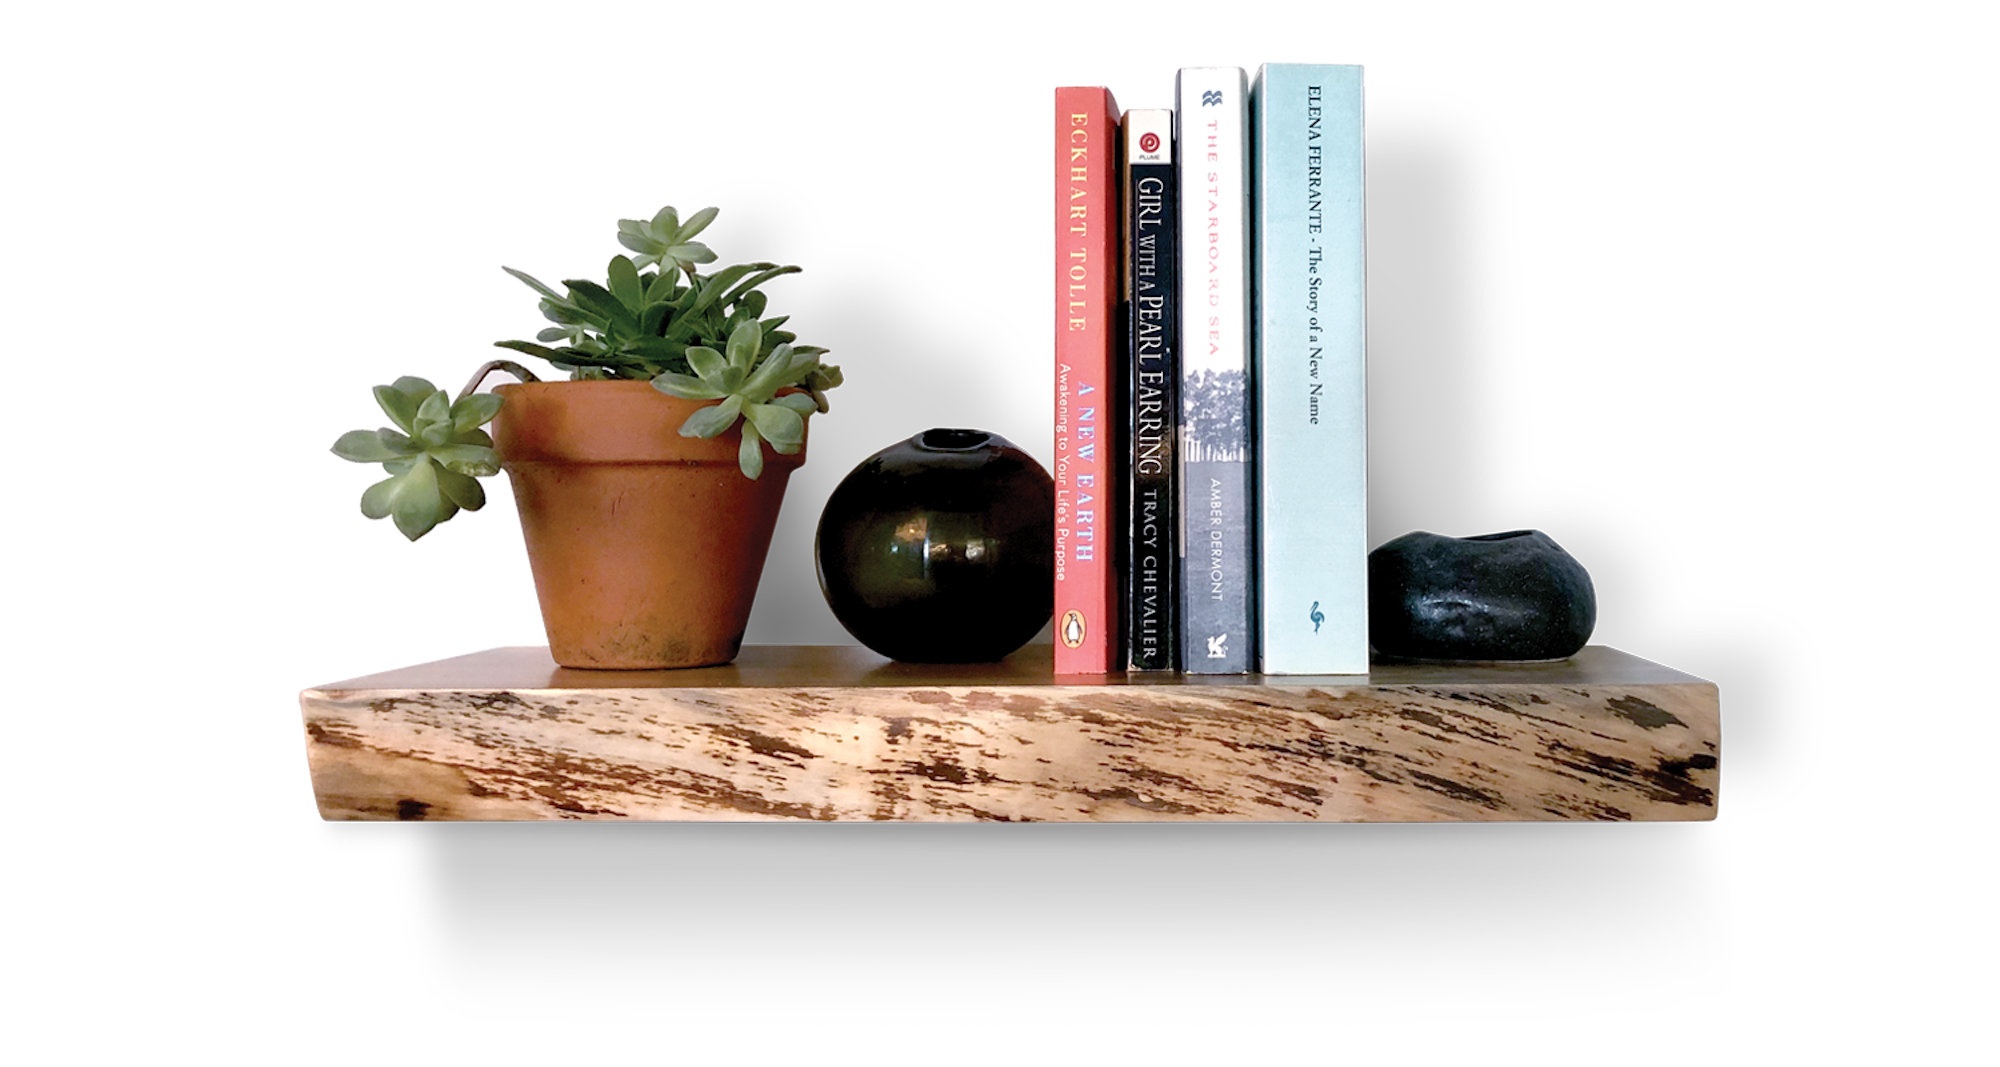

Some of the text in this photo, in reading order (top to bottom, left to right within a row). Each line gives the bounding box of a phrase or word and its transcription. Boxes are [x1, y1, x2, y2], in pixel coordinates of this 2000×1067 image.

[1308, 85, 1322, 141] ELENA
[1069, 113, 1088, 331] ECKHART TOLLE
[1308, 145, 1322, 234] FERRANTE
[1207, 120, 1220, 355] THE STARBOARD SEA
[1309, 246, 1323, 274] The
[1138, 177, 1164, 475] GIRL WITH A PEARL EARRING
[1306, 277, 1323, 314] Story
[1309, 317, 1323, 332] of
[1309, 335, 1318, 343] a
[1309, 347, 1323, 380] New
[1310, 384, 1323, 425] Name
[1055, 363, 1072, 581] Awakening to Your Life's Purpose
[1076, 381, 1095, 561] A NEW EARTH
[1143, 489, 1158, 659] TRACY CHEVALIER
[1210, 478, 1223, 601] AMBER DERMONT
